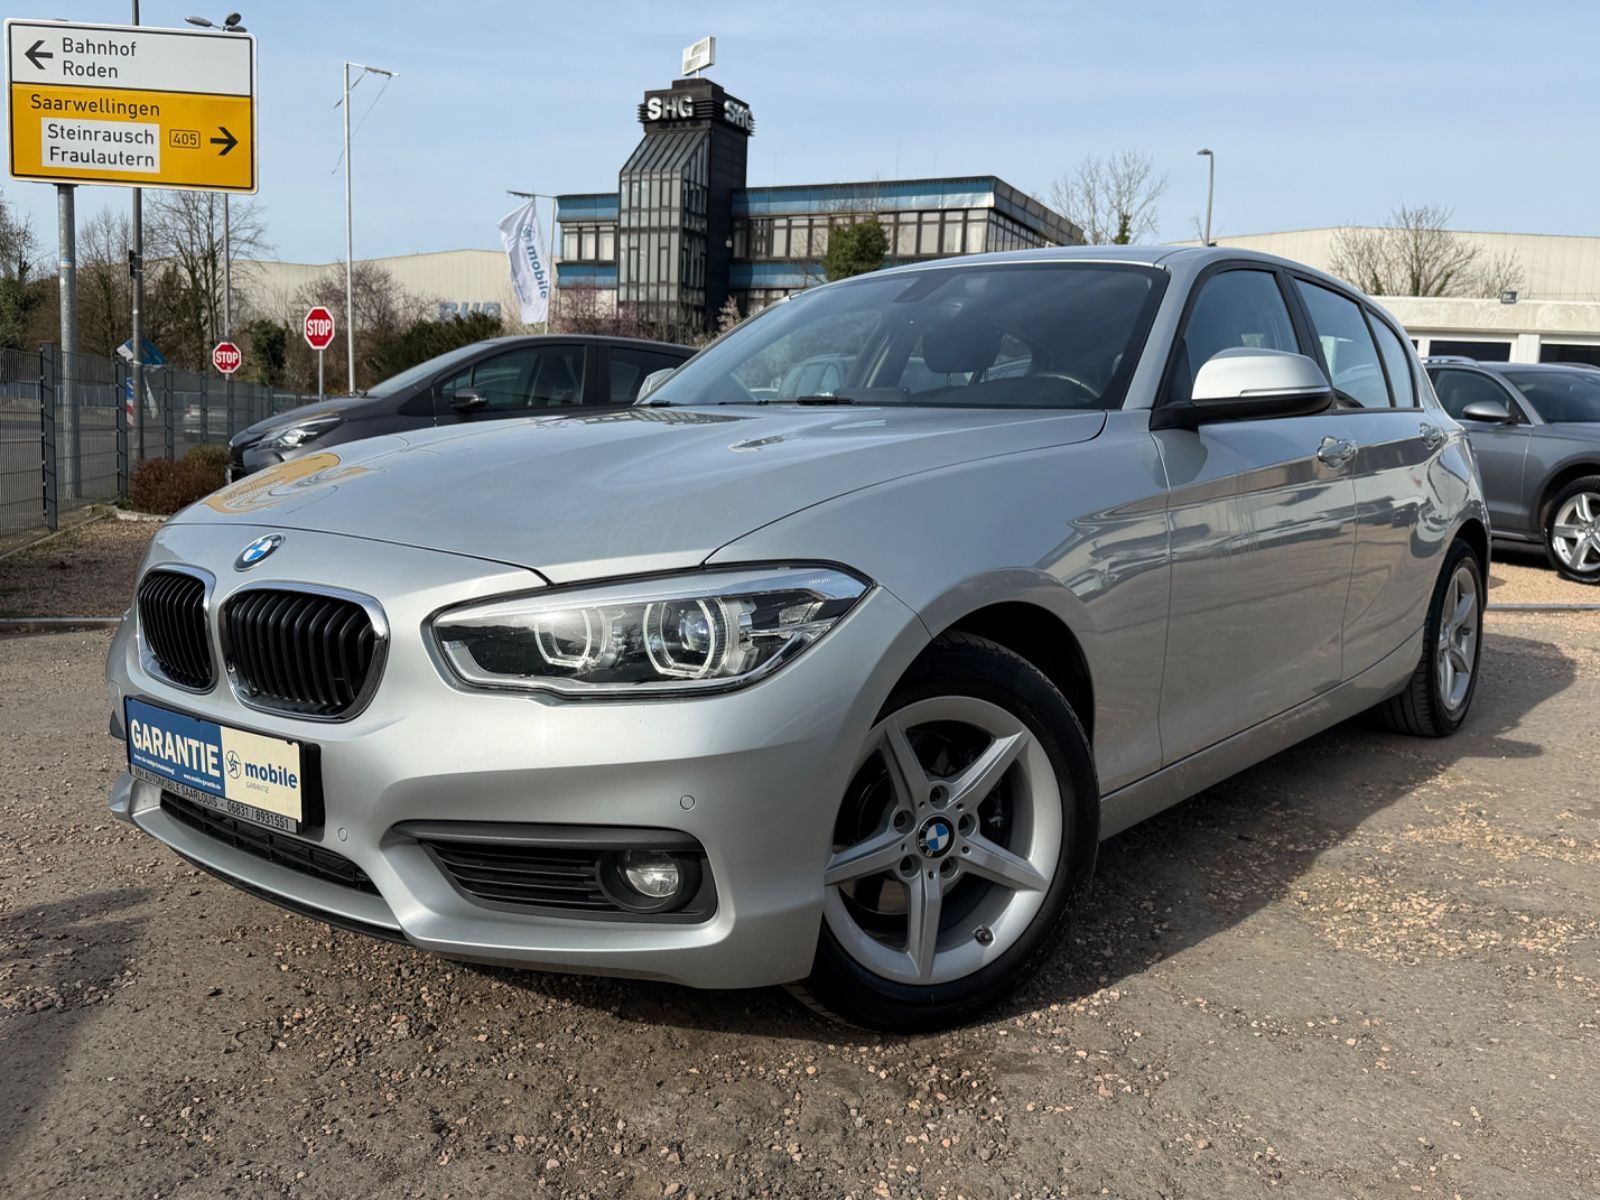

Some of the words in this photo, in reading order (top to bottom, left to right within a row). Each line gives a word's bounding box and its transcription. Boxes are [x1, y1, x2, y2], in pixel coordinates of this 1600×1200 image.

[62, 37, 137, 57] Bahnhof
[63, 60, 118, 79] Roden
[30, 93, 160, 120] Saarwellingen
[647, 95, 693, 120] SHG
[723, 100, 753, 131] SHG
[47, 123, 154, 145] Steinrausch
[172, 132, 197, 146] 405
[49, 146, 155, 167] Fraulautern
[526, 245, 549, 299] mobile
[307, 319, 332, 336] STOP
[215, 351, 239, 364] STOP
[130, 718, 221, 778] GARANTIE
[244, 762, 298, 789] mobile
[145, 770, 180, 793] AUTOMOBILE
[182, 785, 218, 807] SAARLOUIS
[226, 801, 249, 818] 06831
[255, 810, 289, 830] 8931551
